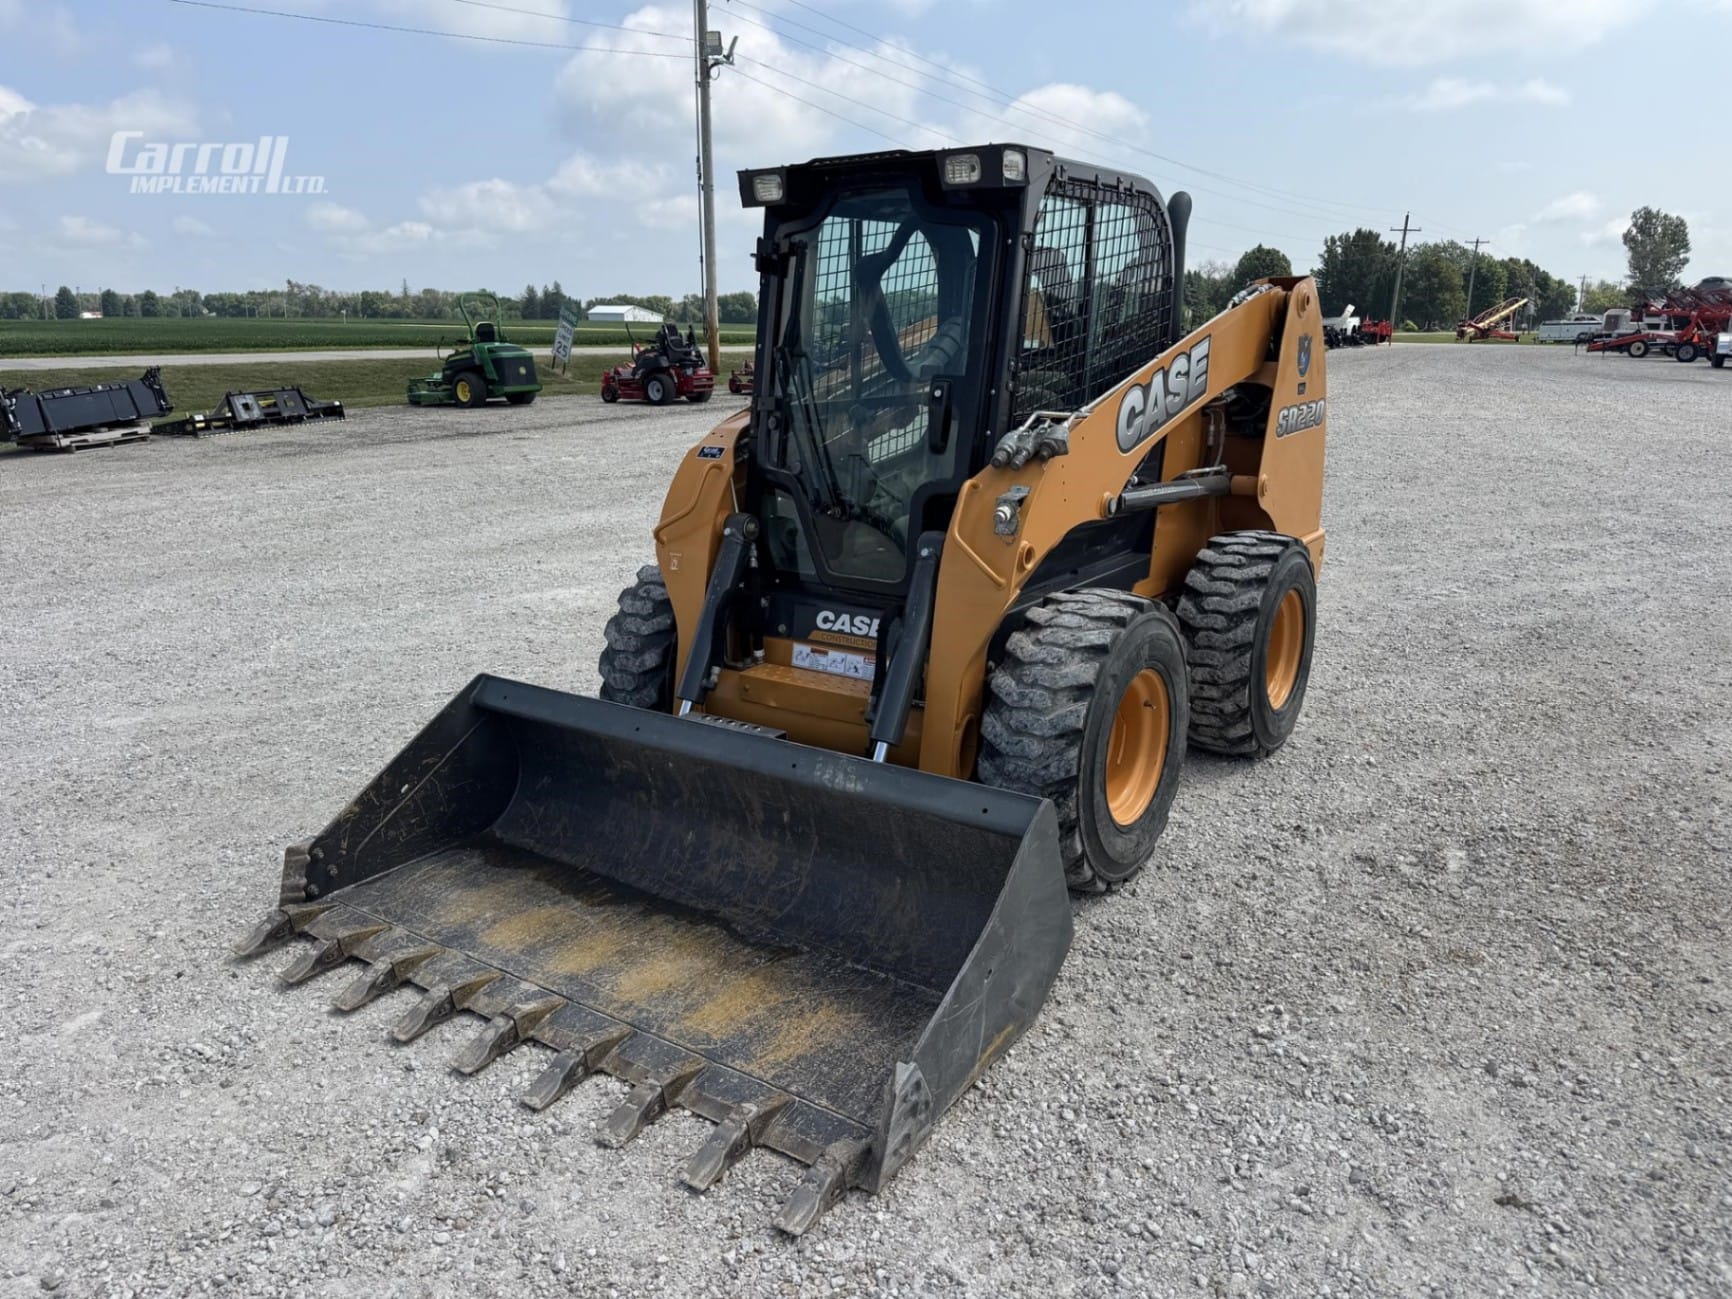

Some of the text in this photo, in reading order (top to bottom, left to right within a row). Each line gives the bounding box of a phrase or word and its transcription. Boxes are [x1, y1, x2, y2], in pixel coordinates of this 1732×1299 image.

[556, 340, 568, 358] 25
[1116, 335, 1211, 452] CASE
[1277, 399, 1326, 437] SR220
[821, 632, 877, 648] CONSTRUCTIO
